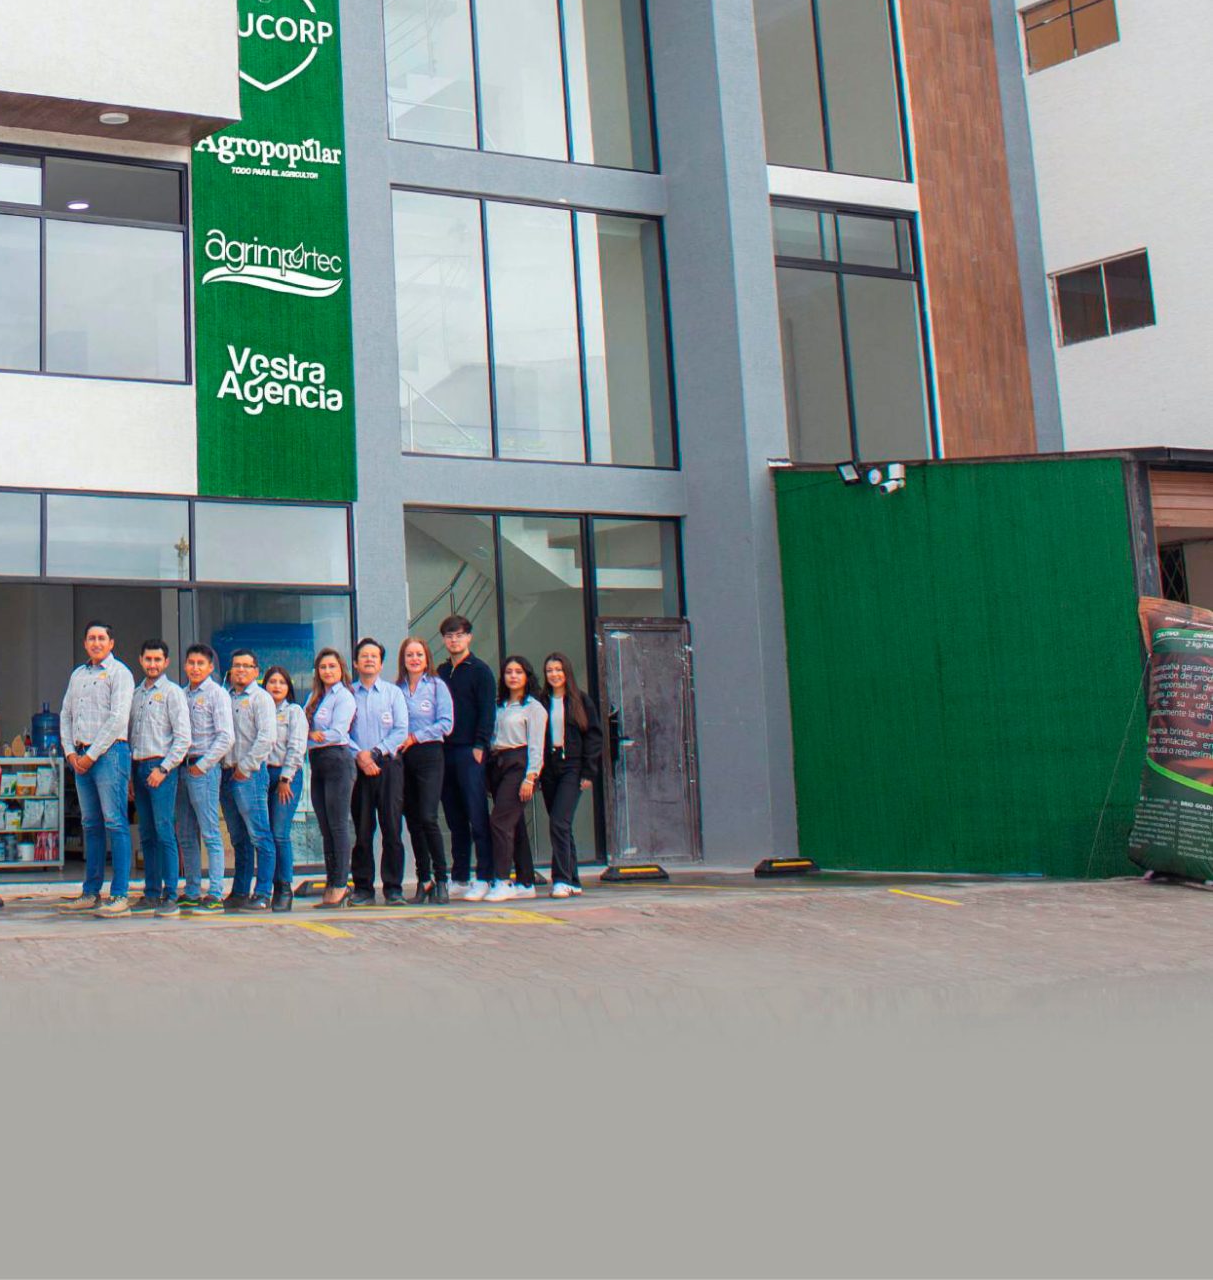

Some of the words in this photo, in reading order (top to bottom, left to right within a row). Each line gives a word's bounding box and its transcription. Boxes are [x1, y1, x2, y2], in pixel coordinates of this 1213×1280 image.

[231, 166, 252, 175] TODO
[252, 167, 271, 177] PARA
[280, 170, 319, 180] AGRICULTOR
[204, 228, 343, 277] agrimportec
[226, 343, 327, 385] Vestra
[216, 370, 344, 415] Agencia
